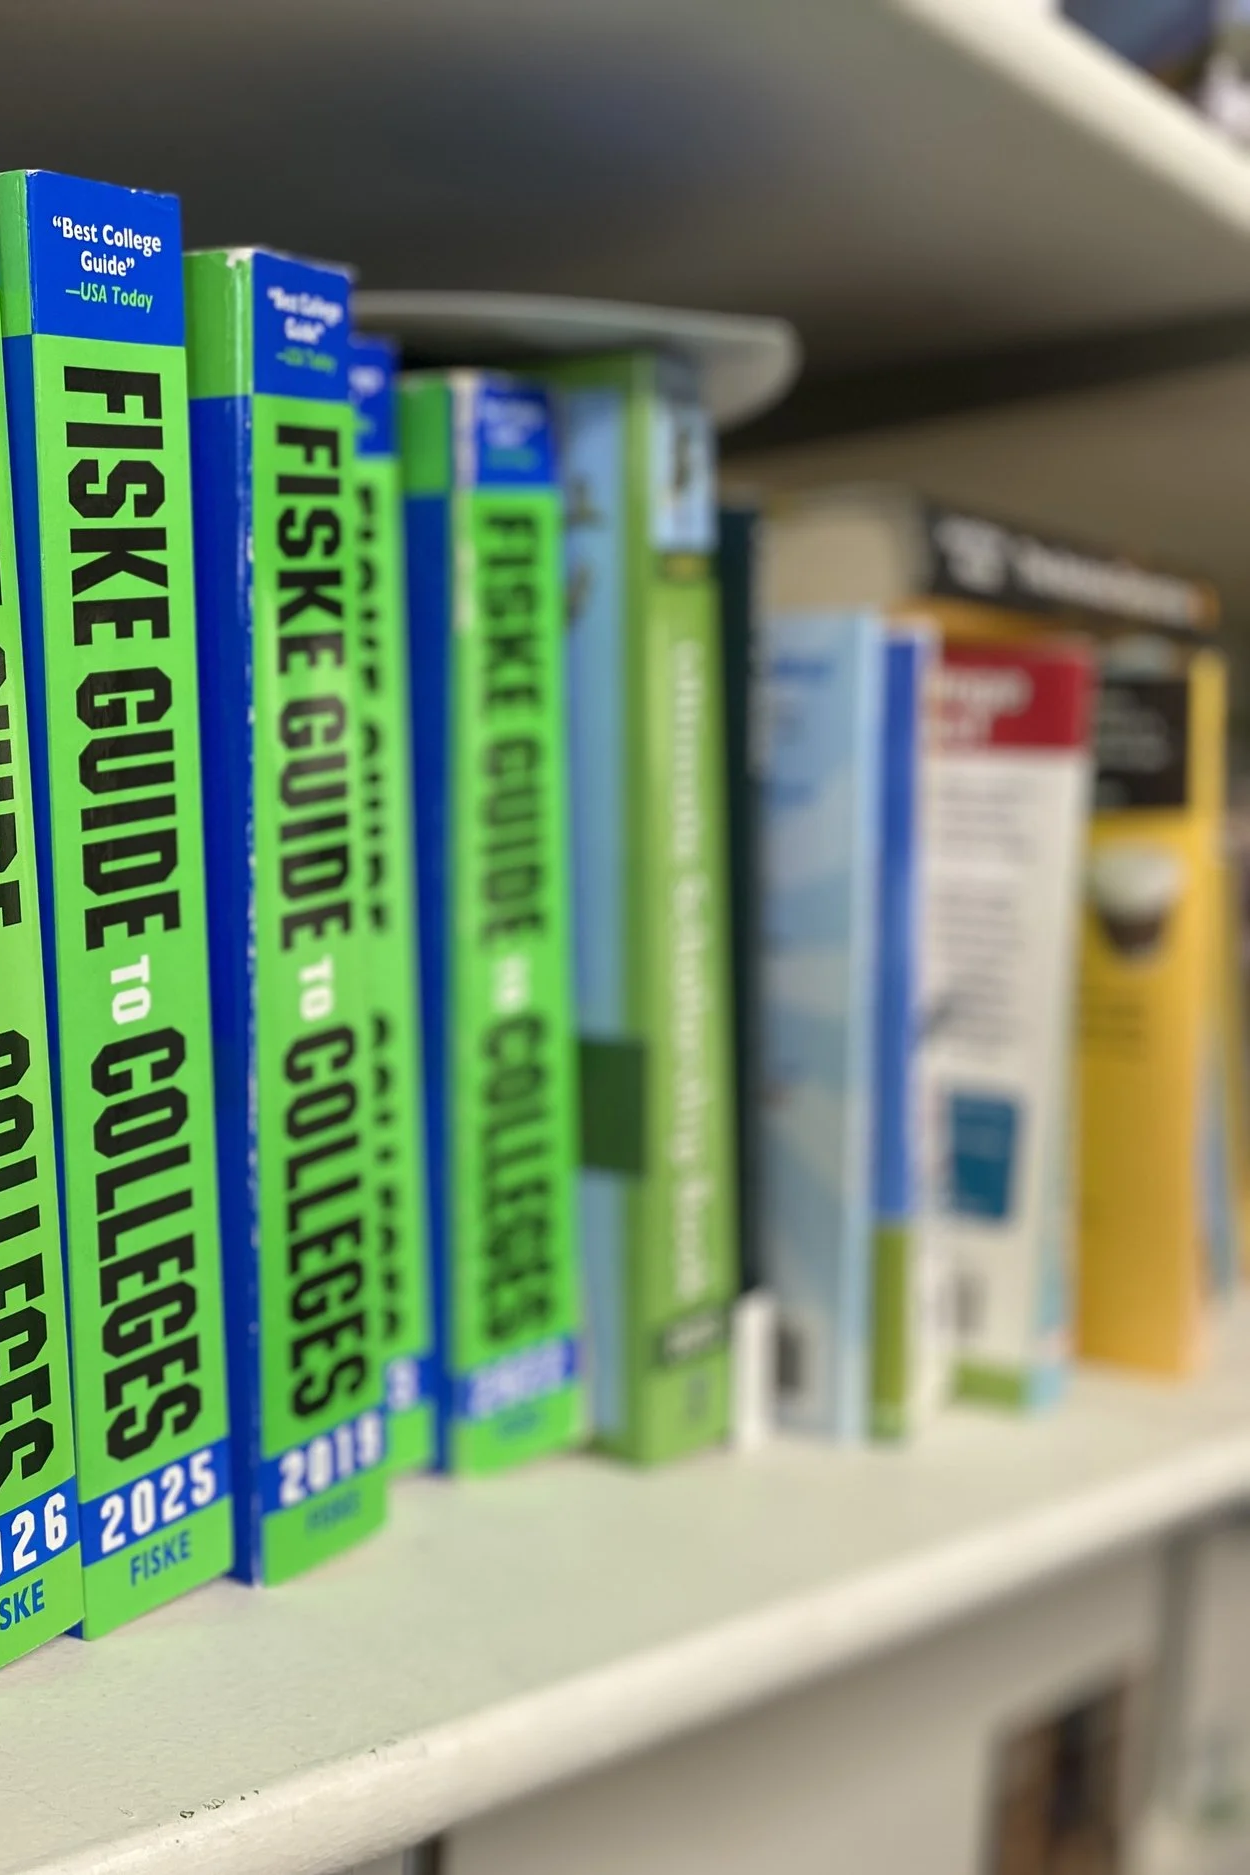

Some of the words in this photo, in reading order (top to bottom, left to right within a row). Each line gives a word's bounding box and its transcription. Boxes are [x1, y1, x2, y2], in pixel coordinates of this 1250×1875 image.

[51, 214, 99, 246] “Best
[101, 222, 163, 258] College
[79, 249, 137, 278] Guide”
[111, 284, 154, 314] Today
[62, 364, 171, 648] FISKE
[274, 422, 346, 677] FISKE
[482, 512, 540, 713] FISKE
[74, 664, 182, 951] GUIDE
[276, 692, 353, 953] GUIDE
[109, 954, 153, 1026] TO
[297, 953, 336, 1023] TO
[88, 1025, 204, 1463] COLLEGES
[281, 1023, 370, 1421] COLLEGES
[98, 1448, 217, 1554] 2025
[128, 1527, 193, 1587] FISKE
